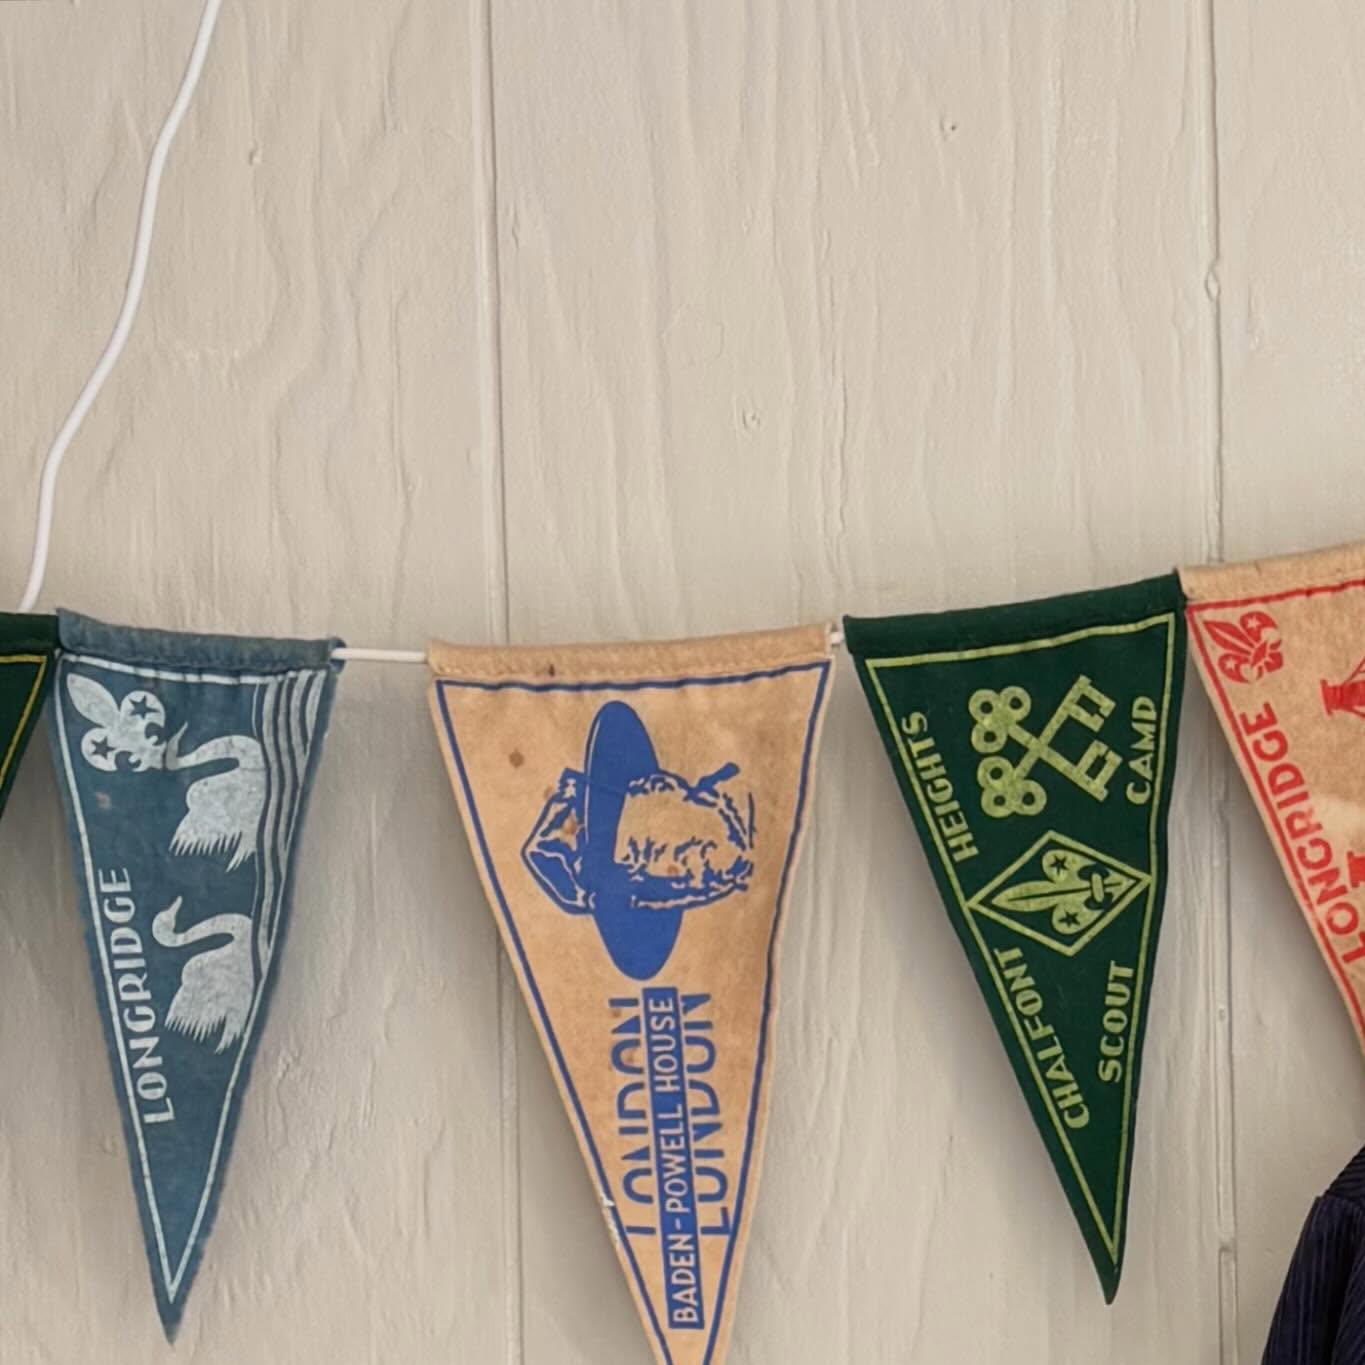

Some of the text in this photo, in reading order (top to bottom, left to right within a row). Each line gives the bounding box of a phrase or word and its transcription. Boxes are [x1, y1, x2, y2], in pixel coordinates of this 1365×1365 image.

[99, 867, 175, 1124] LONGRIDGE
[650, 996, 681, 1092] HOUSE
[902, 711, 1091, 1130] CHALFONT HEIGHTS
[1100, 696, 1158, 1083] SCOUT CAMP
